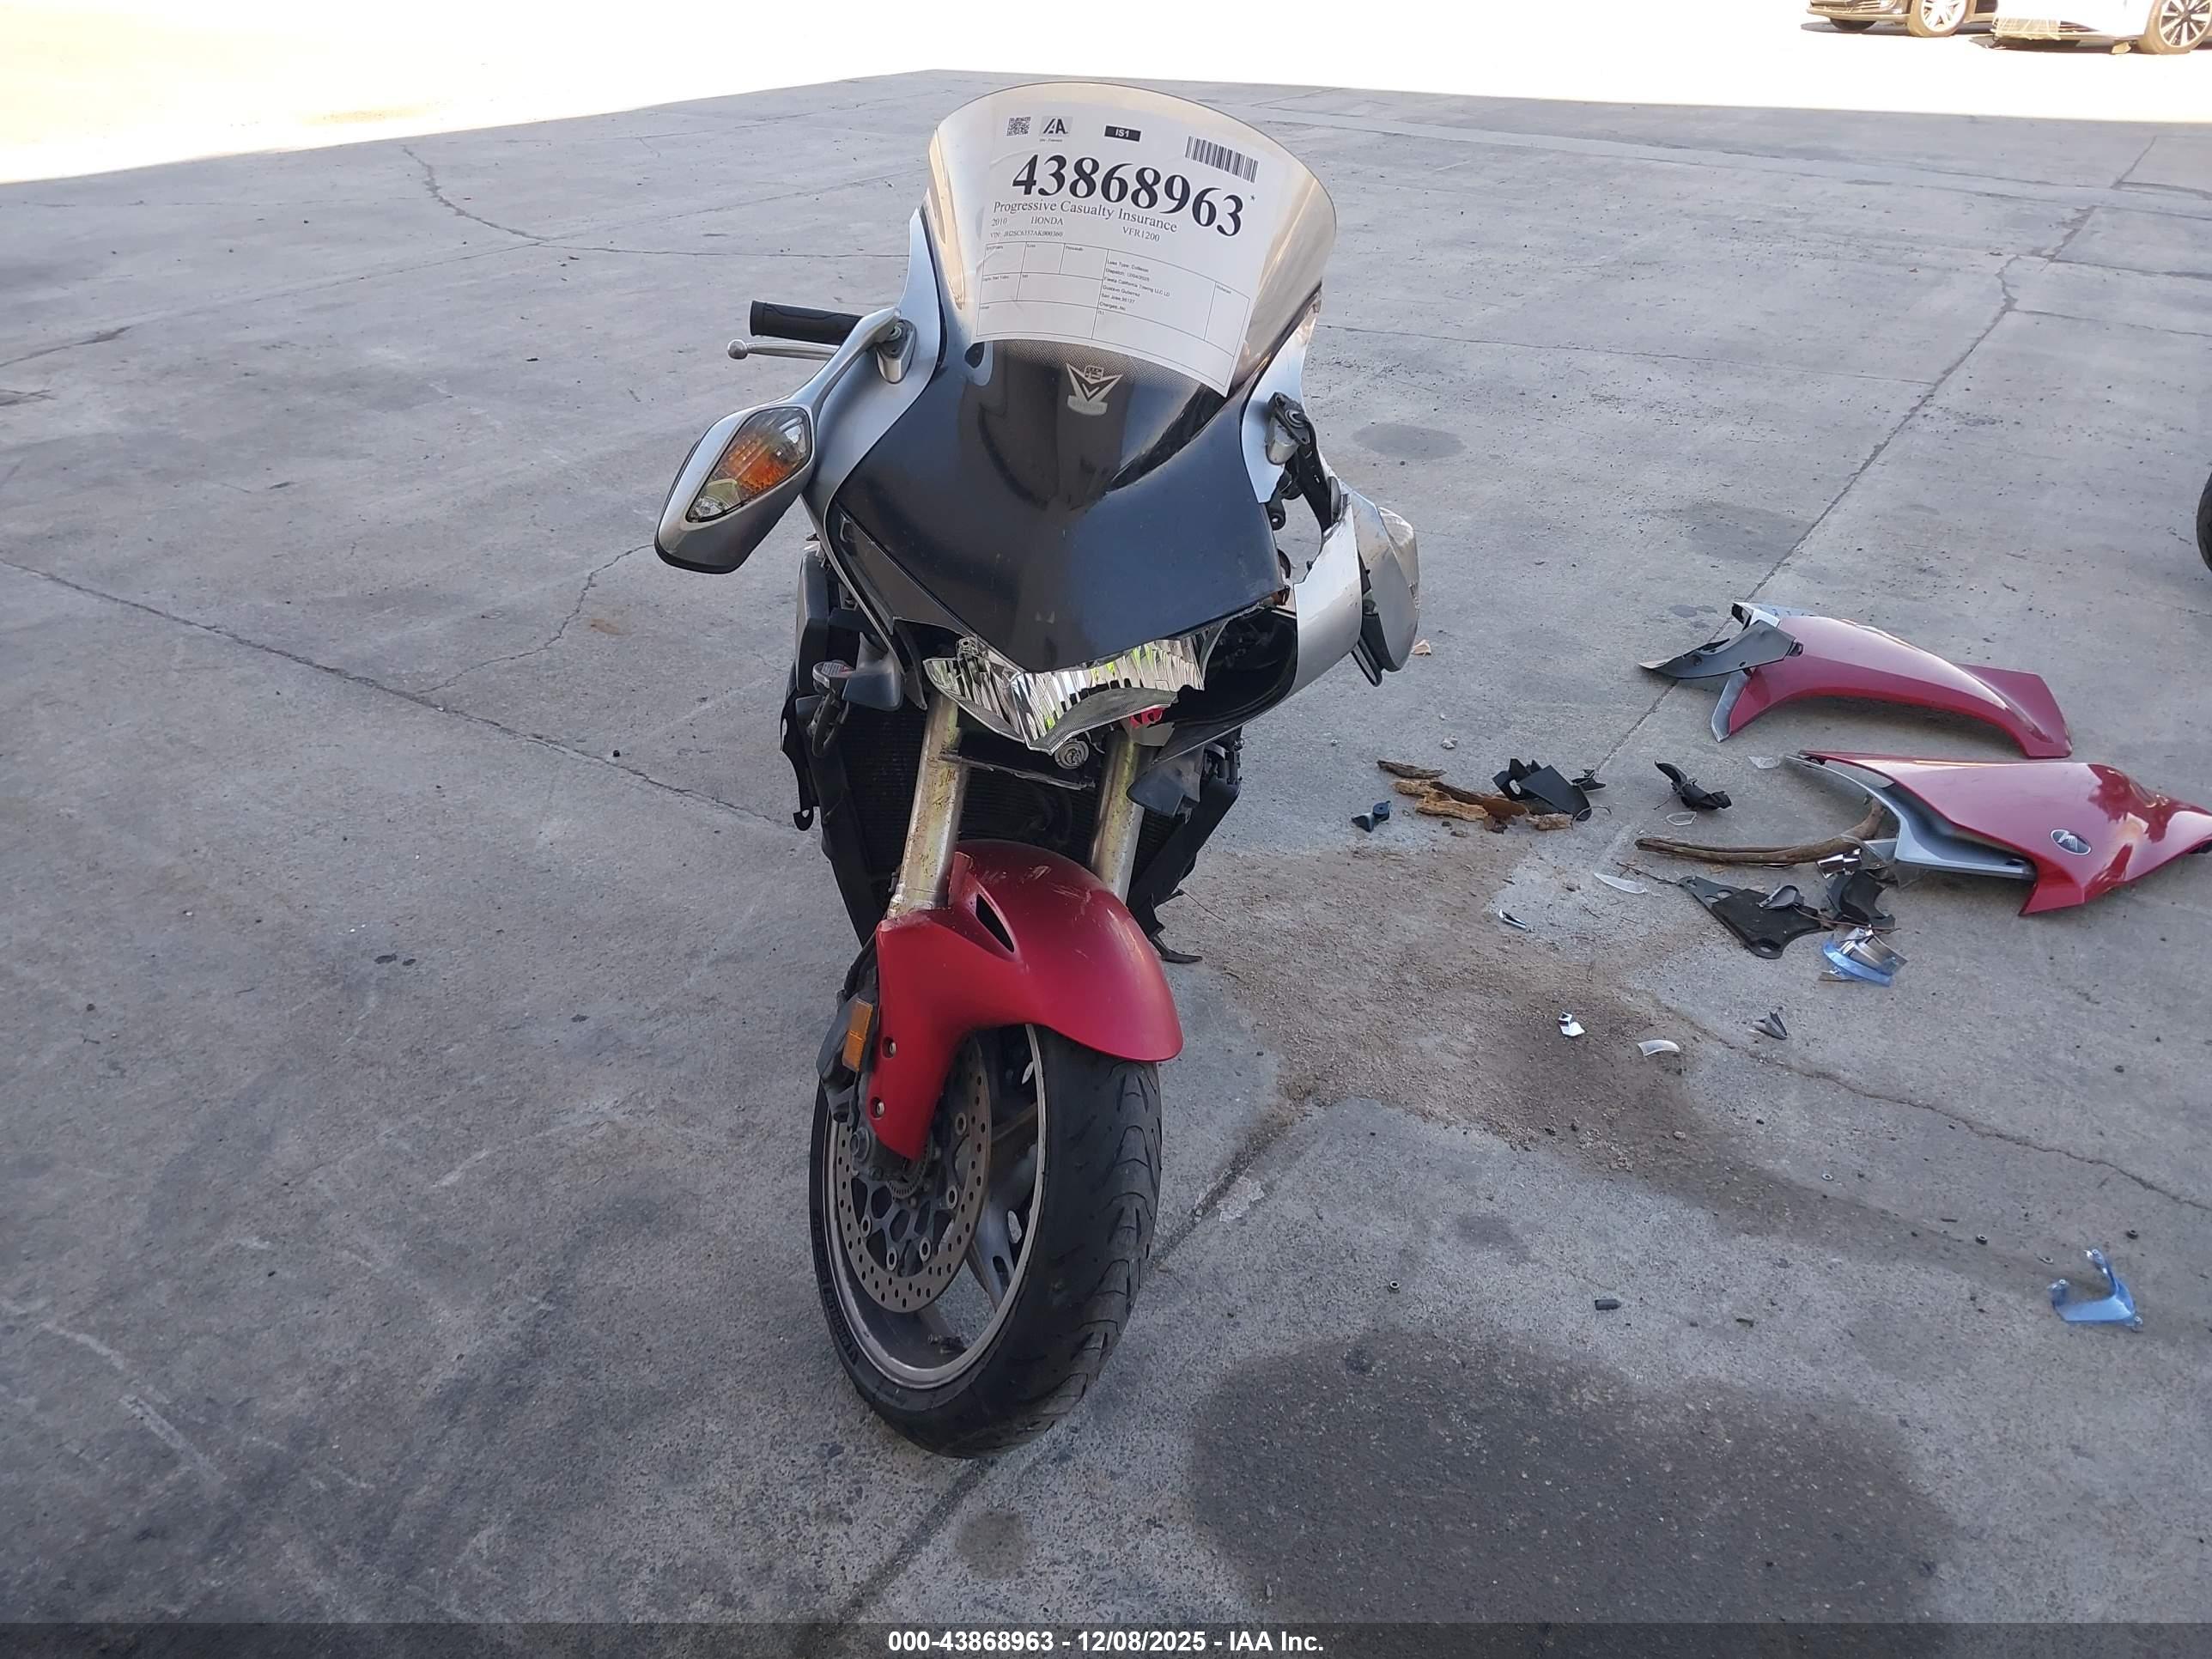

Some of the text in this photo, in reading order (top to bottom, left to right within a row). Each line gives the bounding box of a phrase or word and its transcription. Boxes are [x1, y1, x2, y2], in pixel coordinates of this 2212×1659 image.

[1115, 128, 1130, 138] IS1
[991, 216, 1160, 242] 2010 HONDA VFR1200
[994, 200, 1177, 233] Progressive Casualty Insurance
